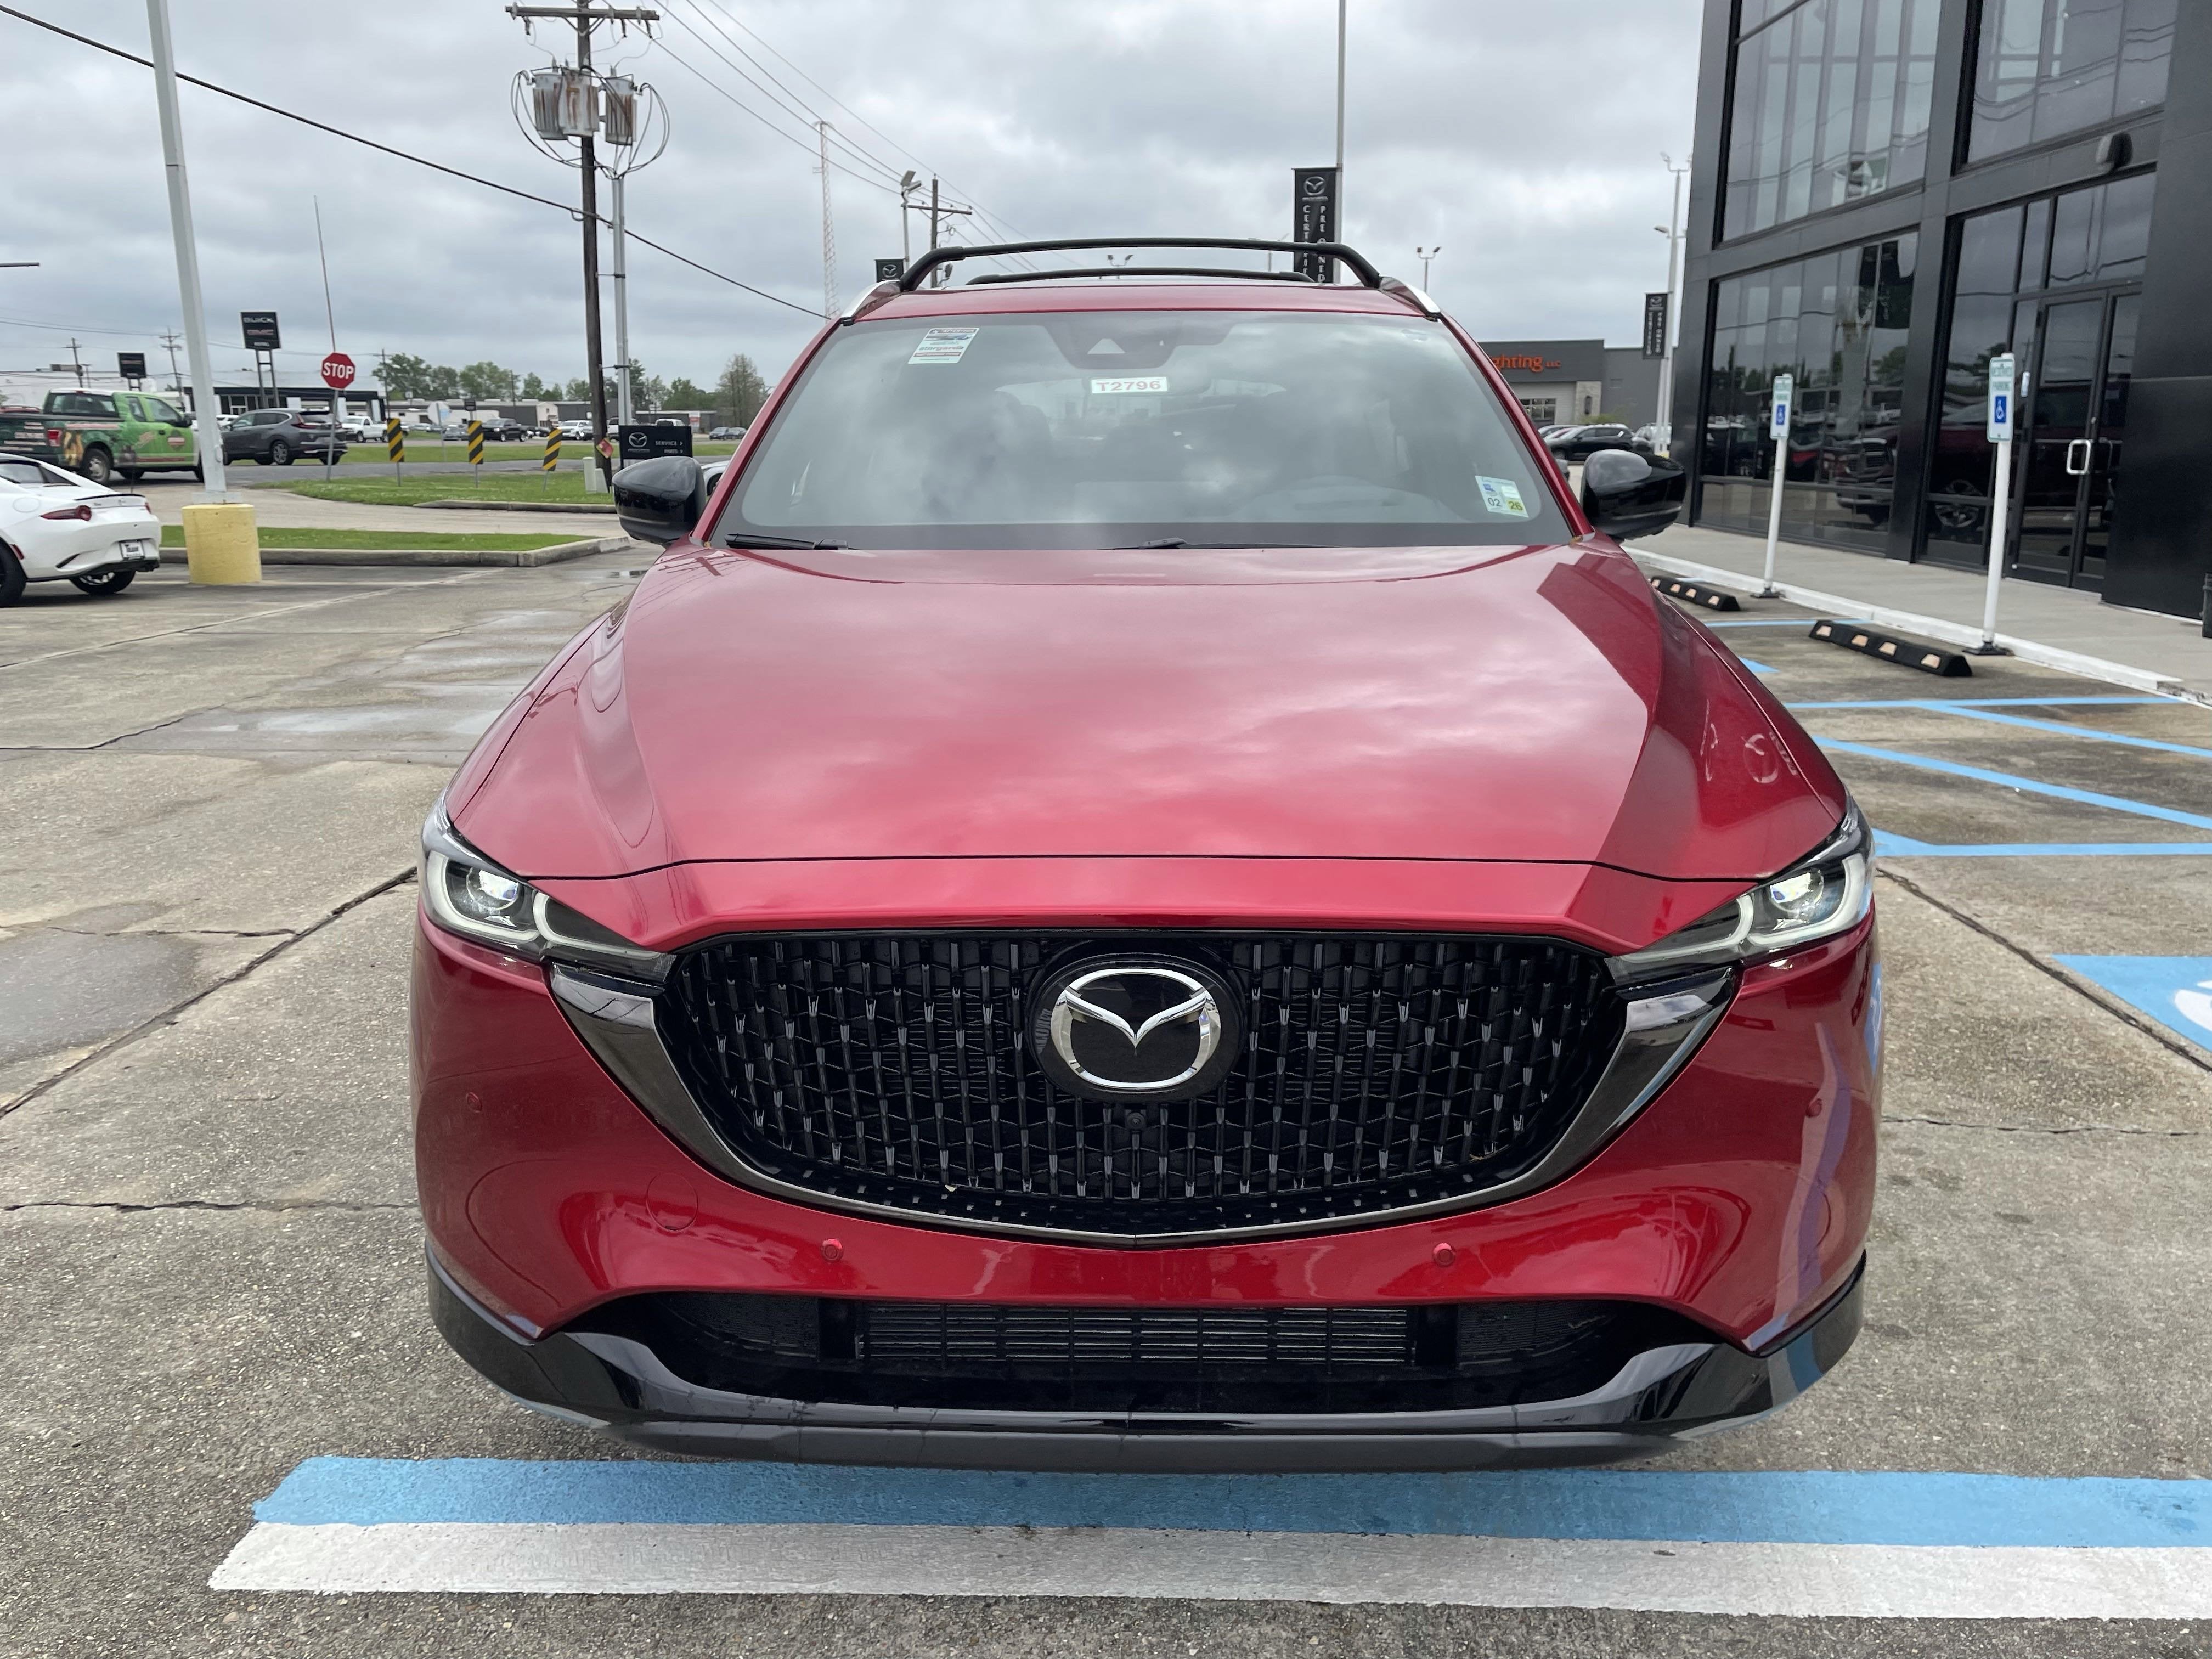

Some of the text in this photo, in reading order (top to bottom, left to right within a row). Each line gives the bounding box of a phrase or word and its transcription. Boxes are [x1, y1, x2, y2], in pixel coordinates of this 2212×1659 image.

[1317, 238, 1326, 283] ONED
[323, 362, 354, 380] STOP
[1096, 381, 1161, 391] T2796
[1488, 497, 1502, 506] 02
